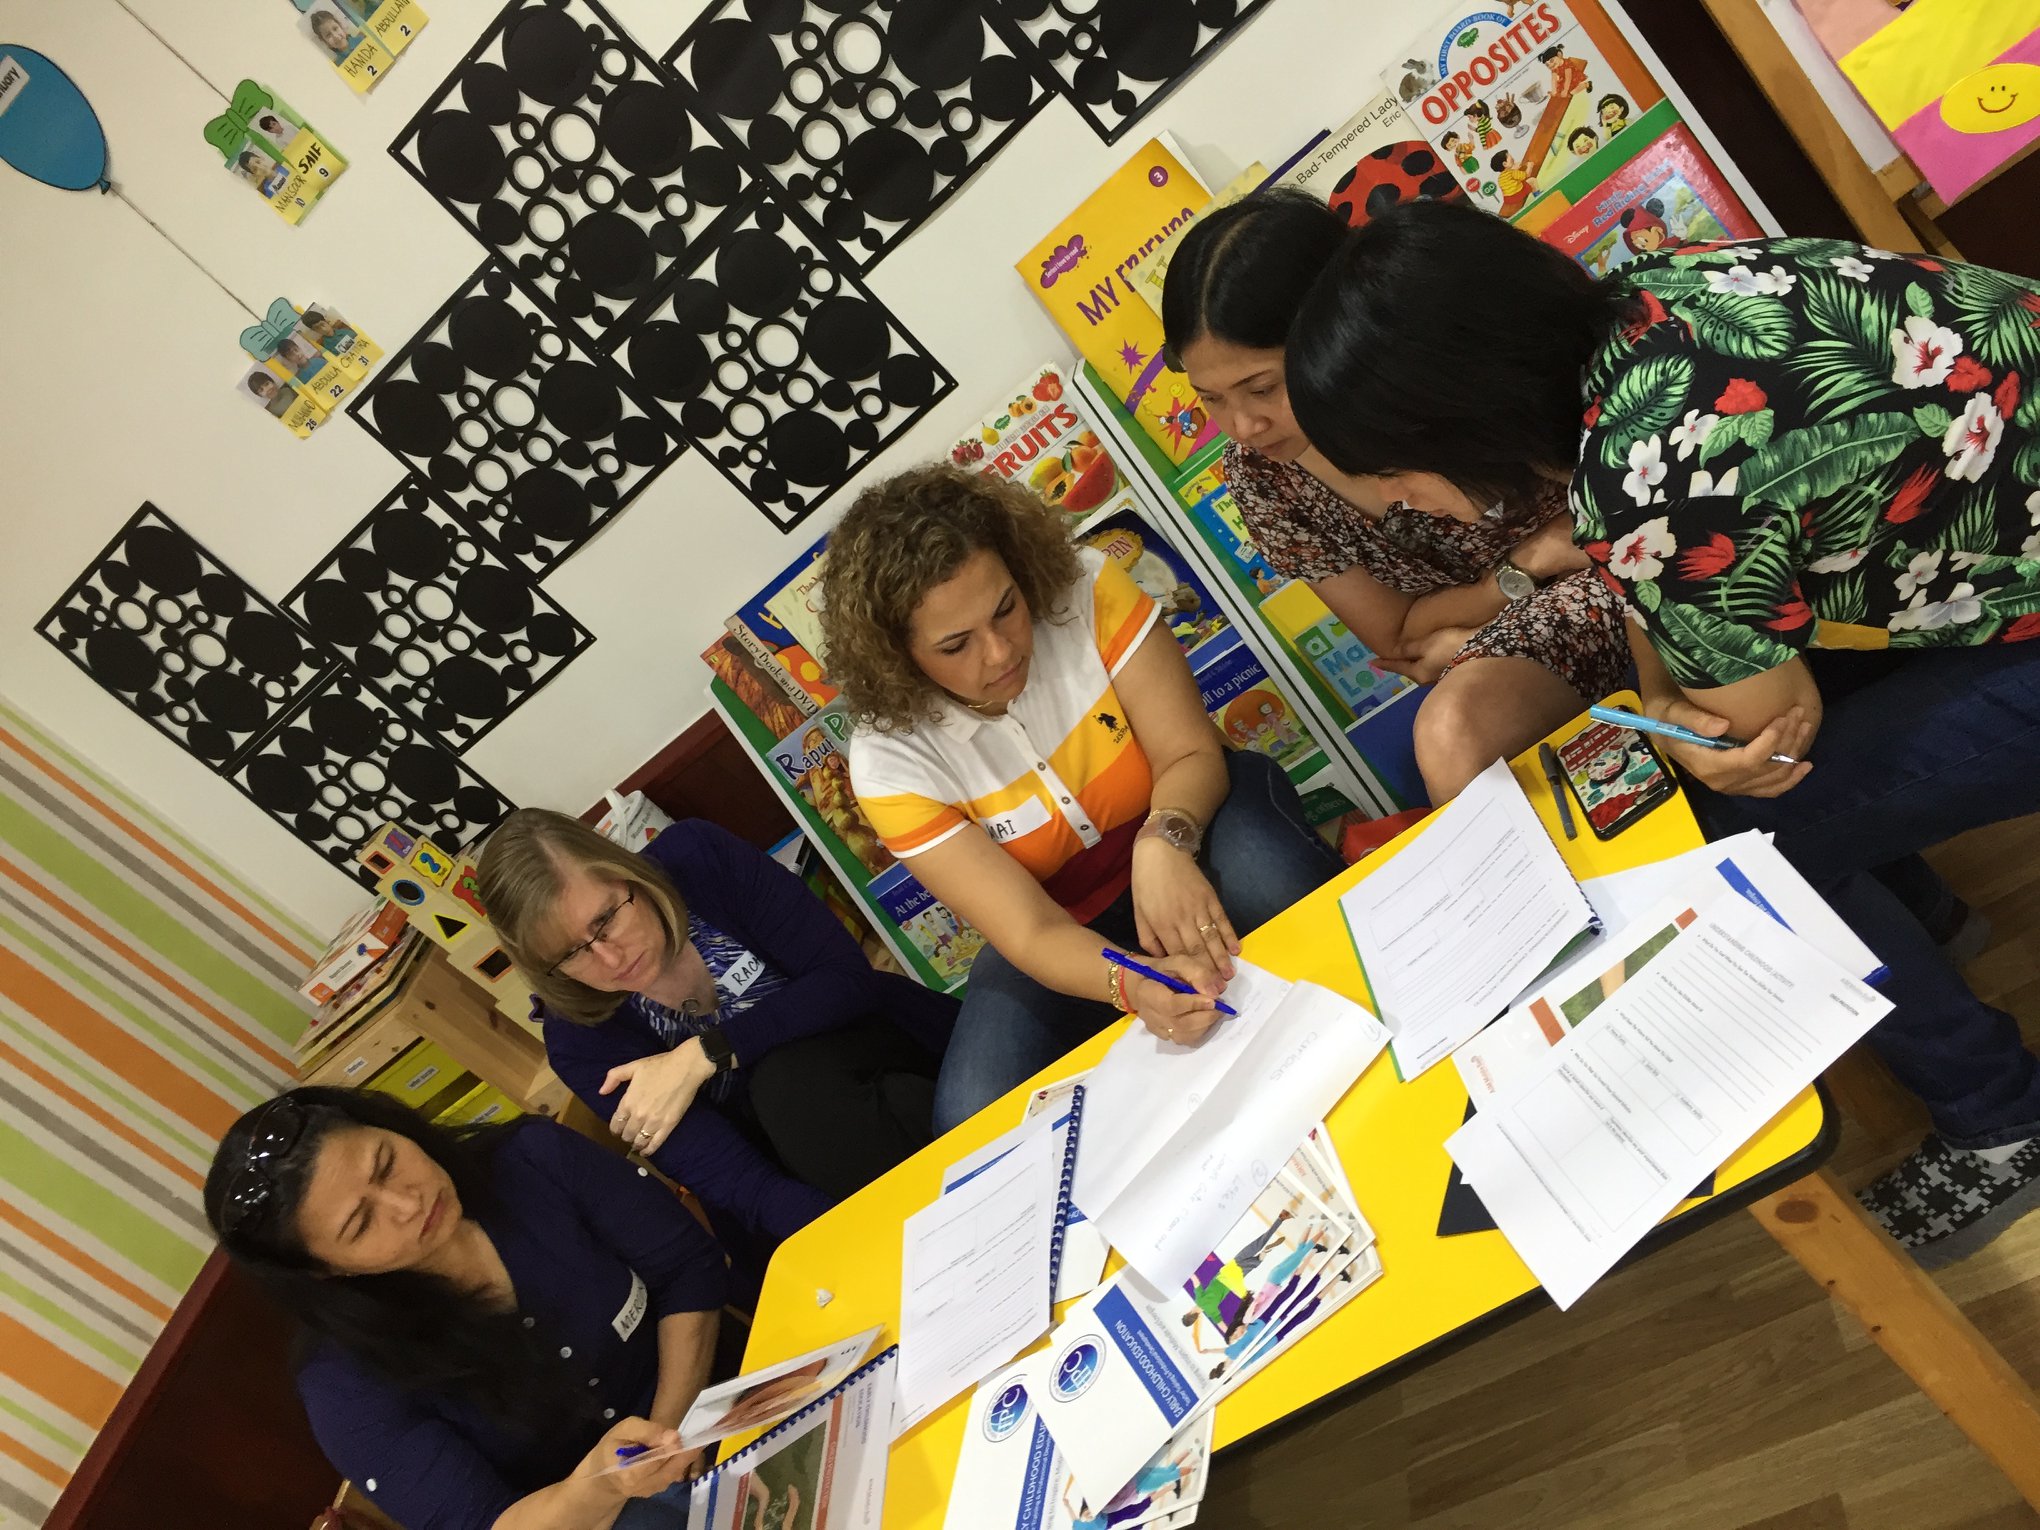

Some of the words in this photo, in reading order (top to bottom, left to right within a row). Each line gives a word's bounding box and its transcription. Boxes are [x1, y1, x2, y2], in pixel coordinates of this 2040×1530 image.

[398, 24, 411, 36] 2
[1439, 39, 1450, 59] FIRST
[1449, 18, 1472, 38] BOARD
[1472, 13, 1494, 21] BOOK
[343, 42, 377, 78] HAMDA
[365, 63, 378, 76] 2
[1422, 2, 1560, 124] OPPOSITES
[1382, 109, 1402, 128] Eric
[1296, 116, 1371, 184] Bad-Tempered
[1370, 95, 1395, 121] Lady
[297, 142, 322, 173] SAIF
[317, 167, 329, 178] 9
[1152, 170, 1164, 183] 3
[1484, 183, 1494, 193] GO
[1563, 224, 1589, 243] Disney
[1075, 275, 1119, 326] MY
[329, 383, 344, 398] 22
[305, 418, 318, 431] 26
[979, 401, 1077, 478] FRUITS
[733, 624, 760, 654] Story
[757, 651, 784, 678] Book
[779, 676, 794, 692] and
[793, 688, 819, 715] DVD
[1321, 644, 1372, 675] Ma
[1212, 686, 1225, 698] to
[1224, 681, 1233, 691] a
[1231, 663, 1261, 689] picnic
[421, 853, 440, 872] 2
[896, 905, 907, 916] At
[904, 897, 919, 909] the
[1114, 1319, 1143, 1357] EDUCATION
[1136, 1329, 1155, 1353] Development
[1063, 1351, 1091, 1388] IPC
[1138, 1354, 1171, 1397] CHILDHOOD
[1150, 1349, 1170, 1374] Professional
[998, 1387, 1019, 1429] IPC
[1164, 1393, 1184, 1417] EARLY
[1023, 1450, 1041, 1518] CHILDHOOD
[1032, 1500, 1040, 1524] Training
[1037, 1457, 1048, 1493] Professional
